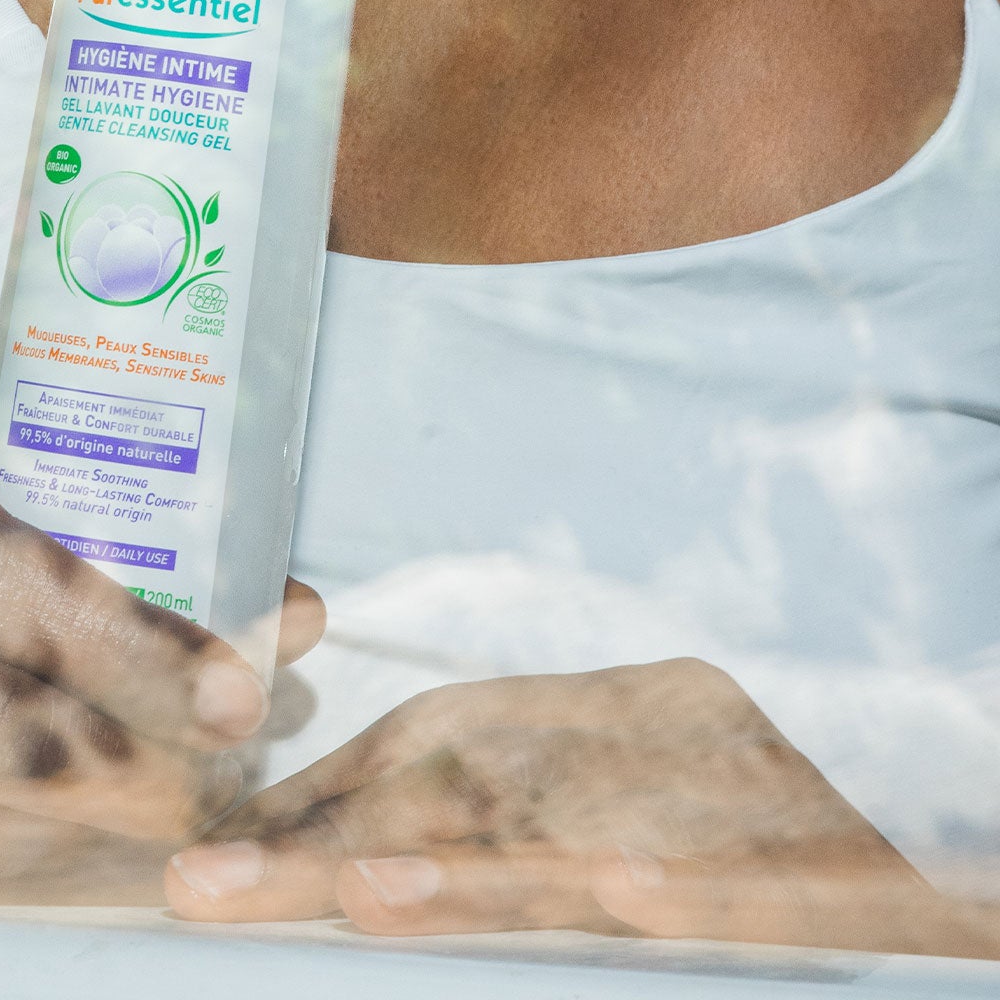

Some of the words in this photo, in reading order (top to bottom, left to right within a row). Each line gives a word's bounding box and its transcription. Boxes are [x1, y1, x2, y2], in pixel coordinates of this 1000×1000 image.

[77, 46, 156, 73] HYGIÈNE
[162, 56, 237, 84] INTIME
[64, 76, 146, 101] INTIMATE
[152, 84, 244, 115] HYGIENE
[61, 98, 82, 112] GEL
[86, 100, 144, 120] LAVANT
[149, 108, 229, 132] DOUCEUR
[58, 117, 103, 133] GENTLE
[108, 121, 198, 146] CLEANSING
[202, 134, 232, 151] GEL
[57, 151, 68, 159] BIO
[47, 162, 77, 174] ORGANIC
[183, 324, 224, 337] ORGANIC
[185, 314, 225, 327] COSMOS
[72, 415, 80, 426] &
[19, 428, 52, 445] 99,5%
[55, 433, 114, 454] d'origine
[117, 445, 181, 465] naturelle
[49, 479, 58, 490] &
[25, 491, 59, 507] 99.5%
[63, 499, 110, 515] natural
[114, 507, 152, 523] origin
[111, 546, 143, 562] DAILY
[146, 551, 170, 565] USE
[147, 591, 173, 608] 200
[175, 596, 193, 612] ml
